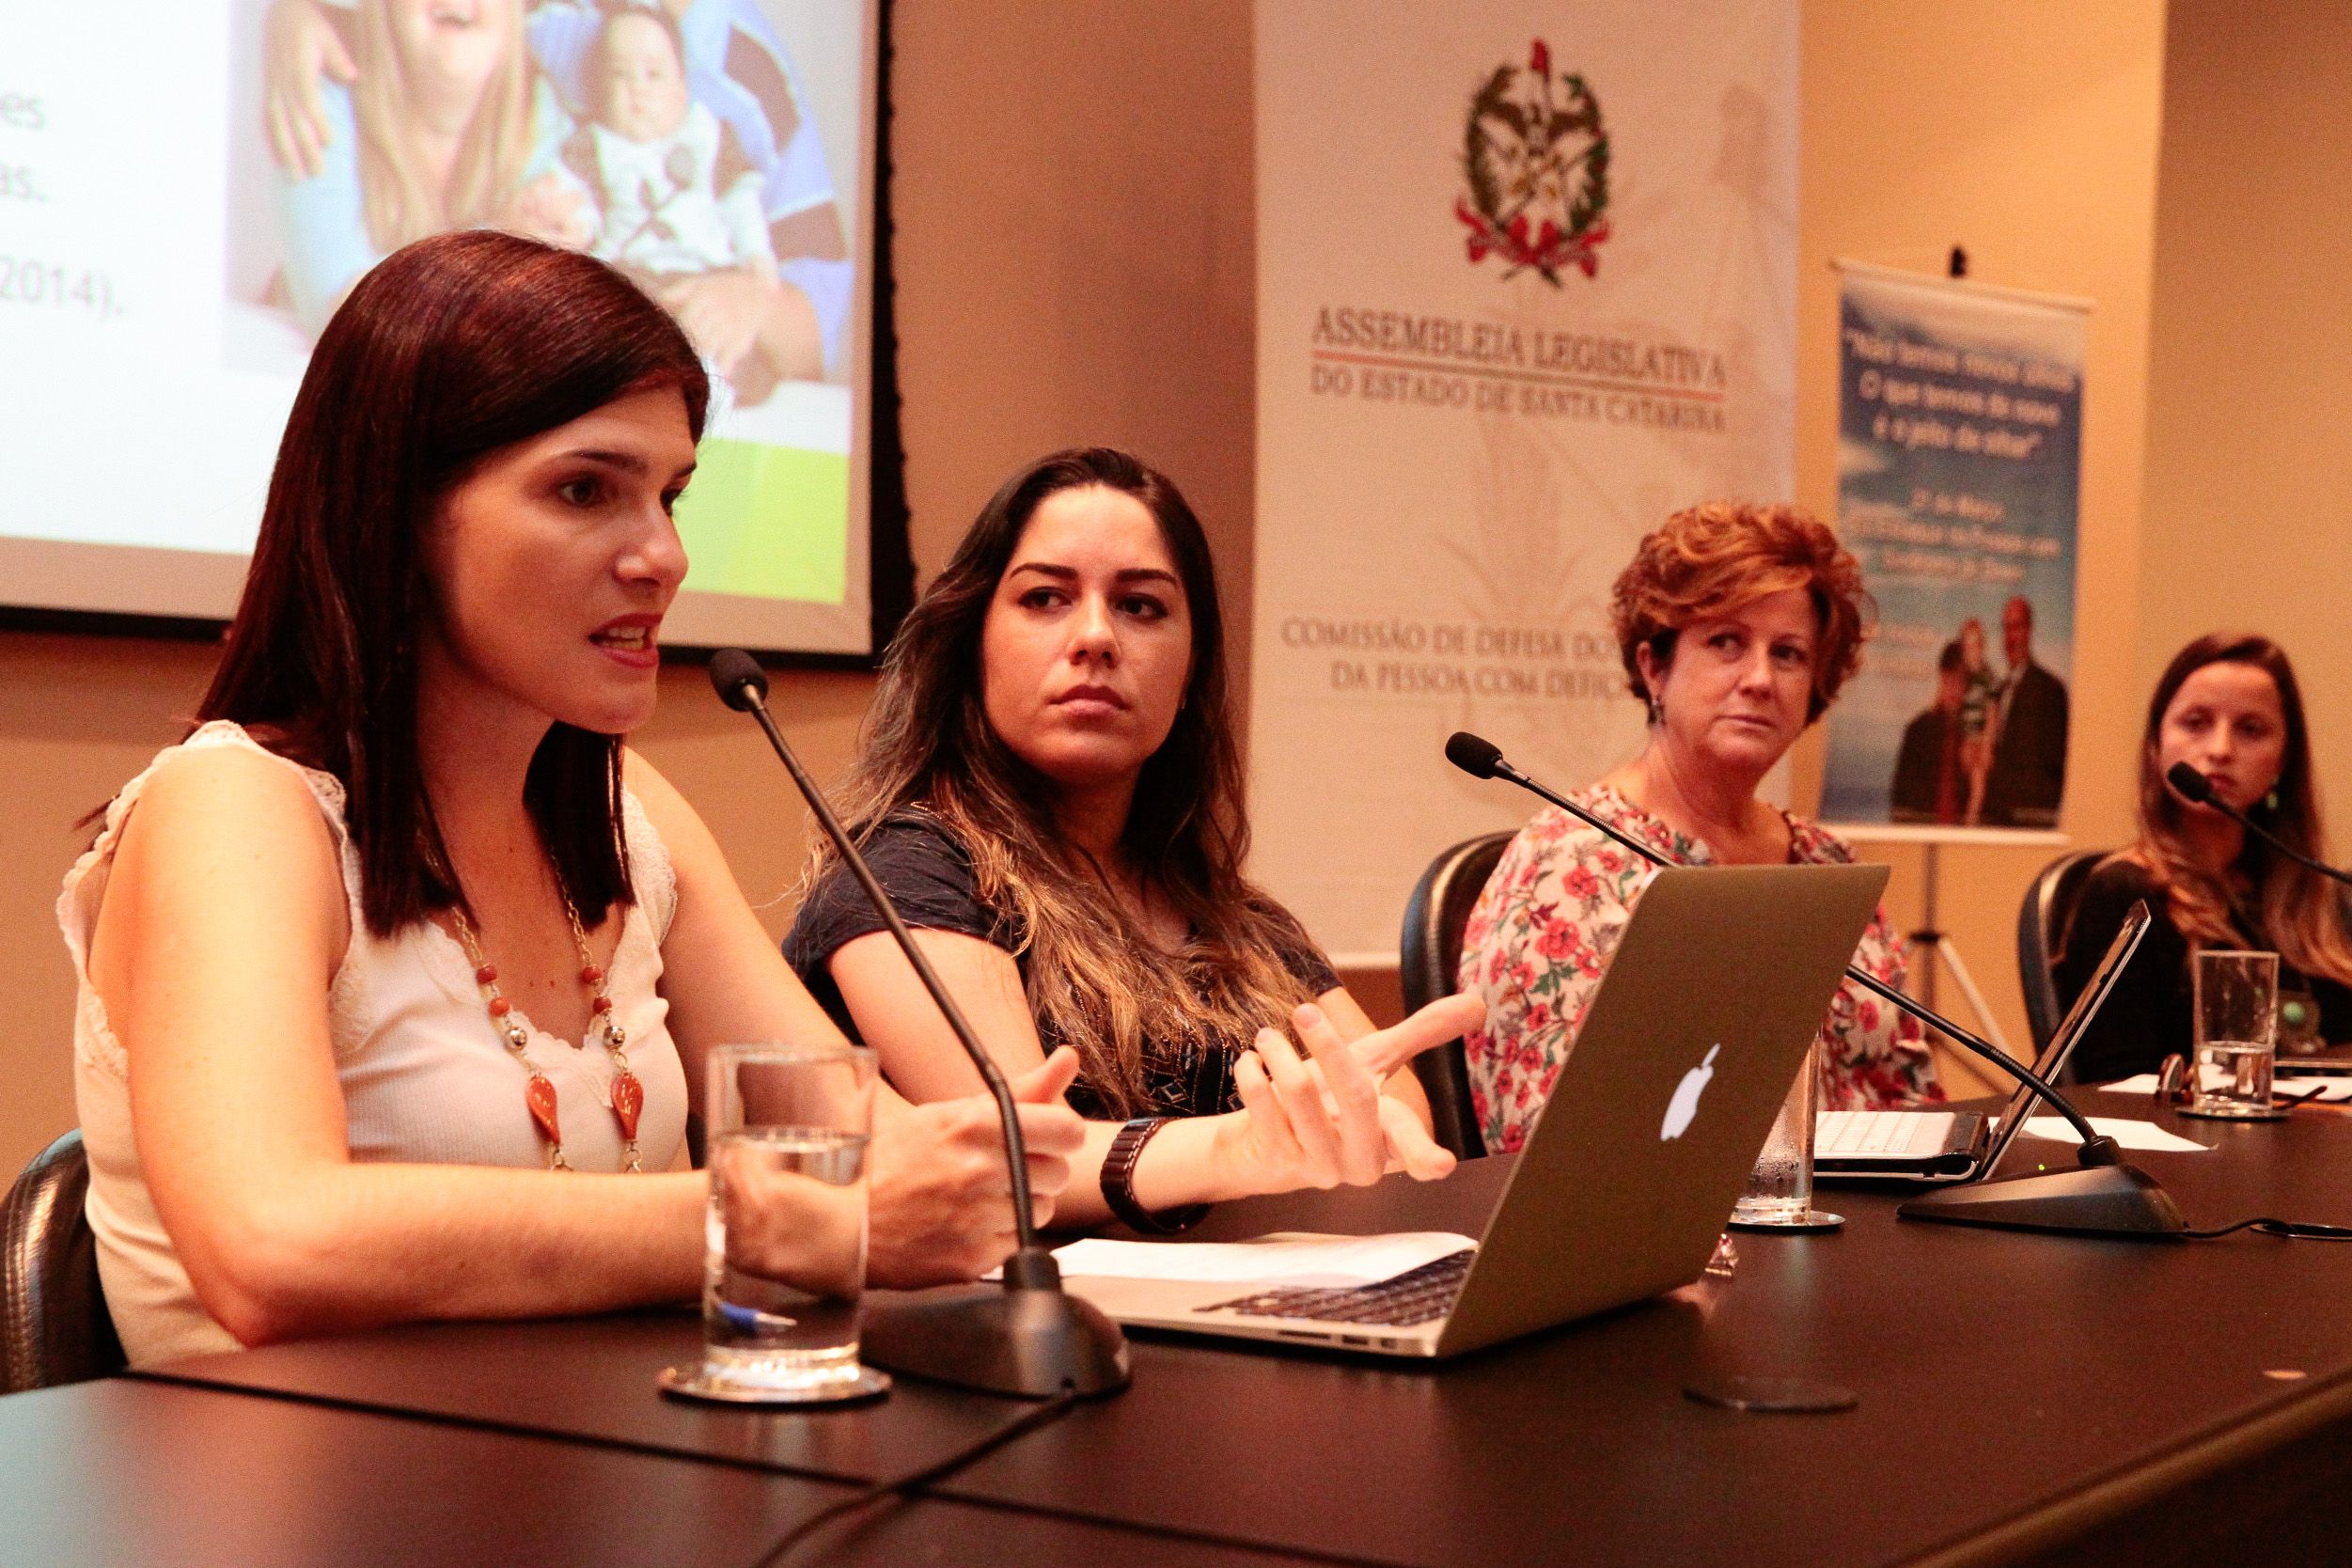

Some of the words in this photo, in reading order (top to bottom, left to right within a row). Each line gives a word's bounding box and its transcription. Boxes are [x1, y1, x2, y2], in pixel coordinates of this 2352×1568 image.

[1311, 306, 1524, 367] ASSEMBLEIA
[1533, 330, 1727, 387] LEGISLATIVA
[1310, 364, 1352, 397] DO
[1360, 369, 1469, 409] ESTADO
[1476, 382, 1510, 413] DE
[1519, 386, 1599, 420] SANTA
[1606, 396, 1726, 433] CATARINA
[1280, 615, 1427, 653] COMISSÃO
[1433, 625, 1466, 656] DE
[1474, 626, 1565, 660] DEFESA
[1330, 661, 1369, 691] DA
[1376, 662, 1468, 695] PESSOA
[1474, 666, 1539, 697] COM
